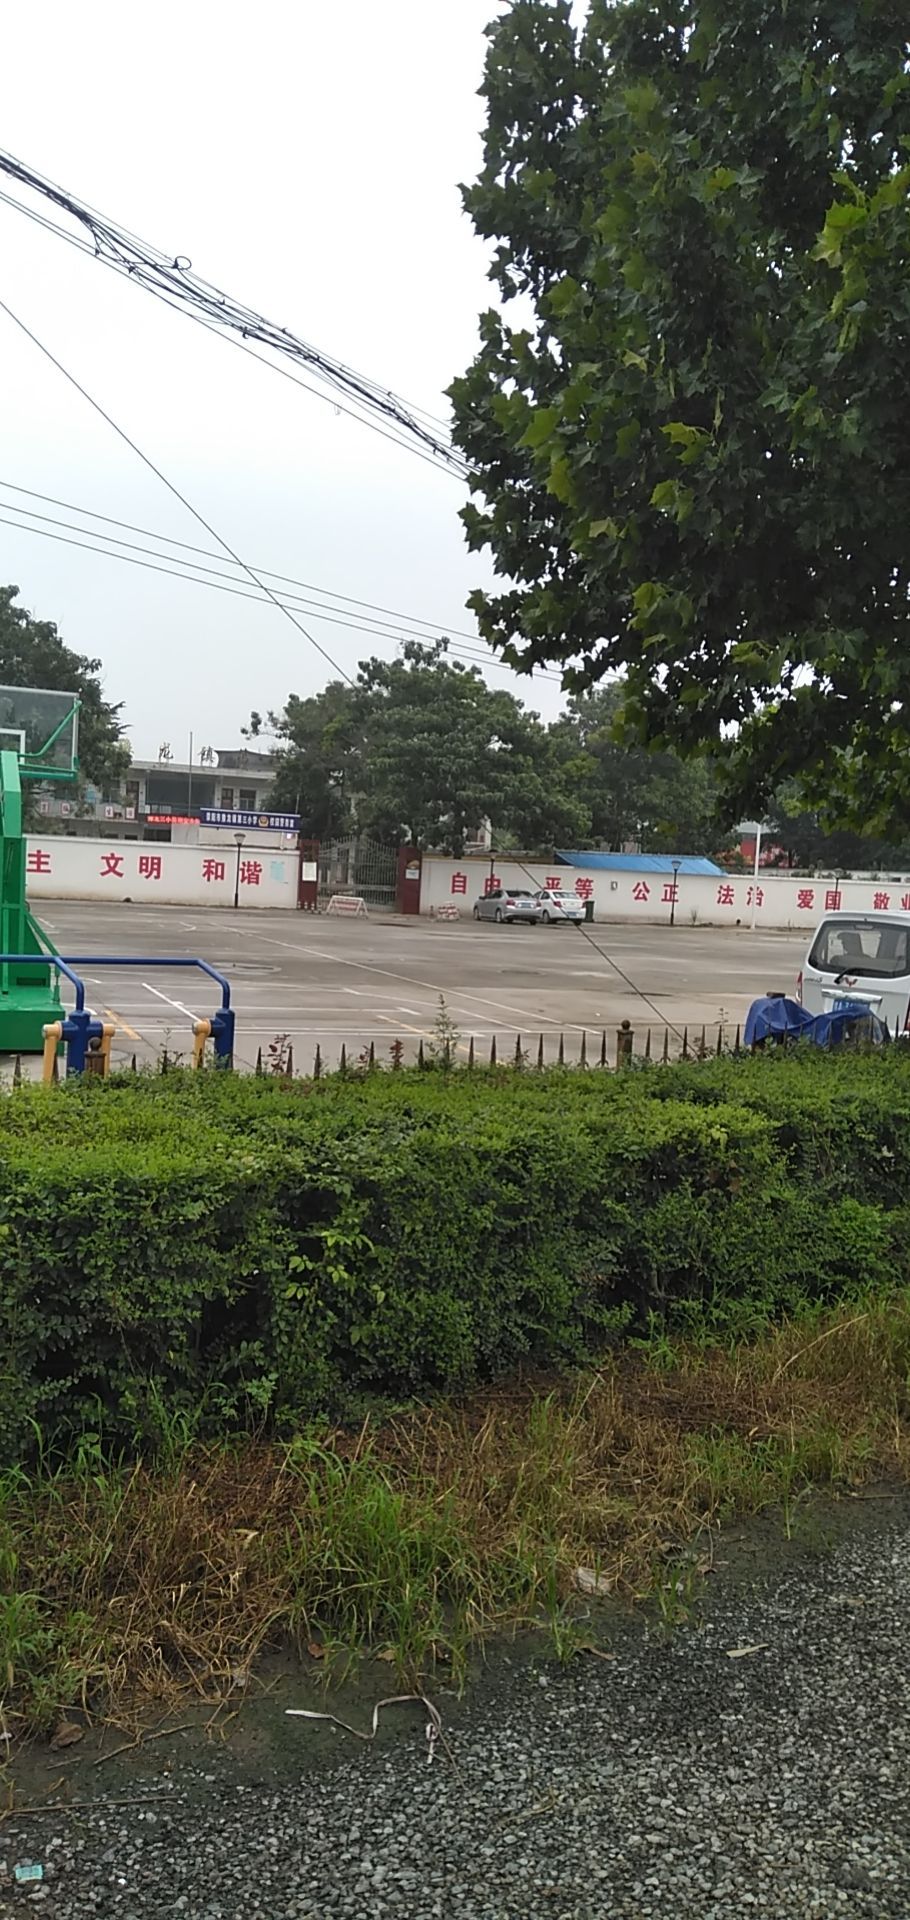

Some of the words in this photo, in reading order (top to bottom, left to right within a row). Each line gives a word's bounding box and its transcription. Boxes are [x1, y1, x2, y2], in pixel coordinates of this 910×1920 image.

[27, 849, 52, 874] 主
[100, 853, 162, 880] 文明
[202, 859, 263, 885] 和谐
[632, 881, 680, 903] 公正
[716, 885, 765, 907] 法治
[797, 889, 842, 911] 爱国
